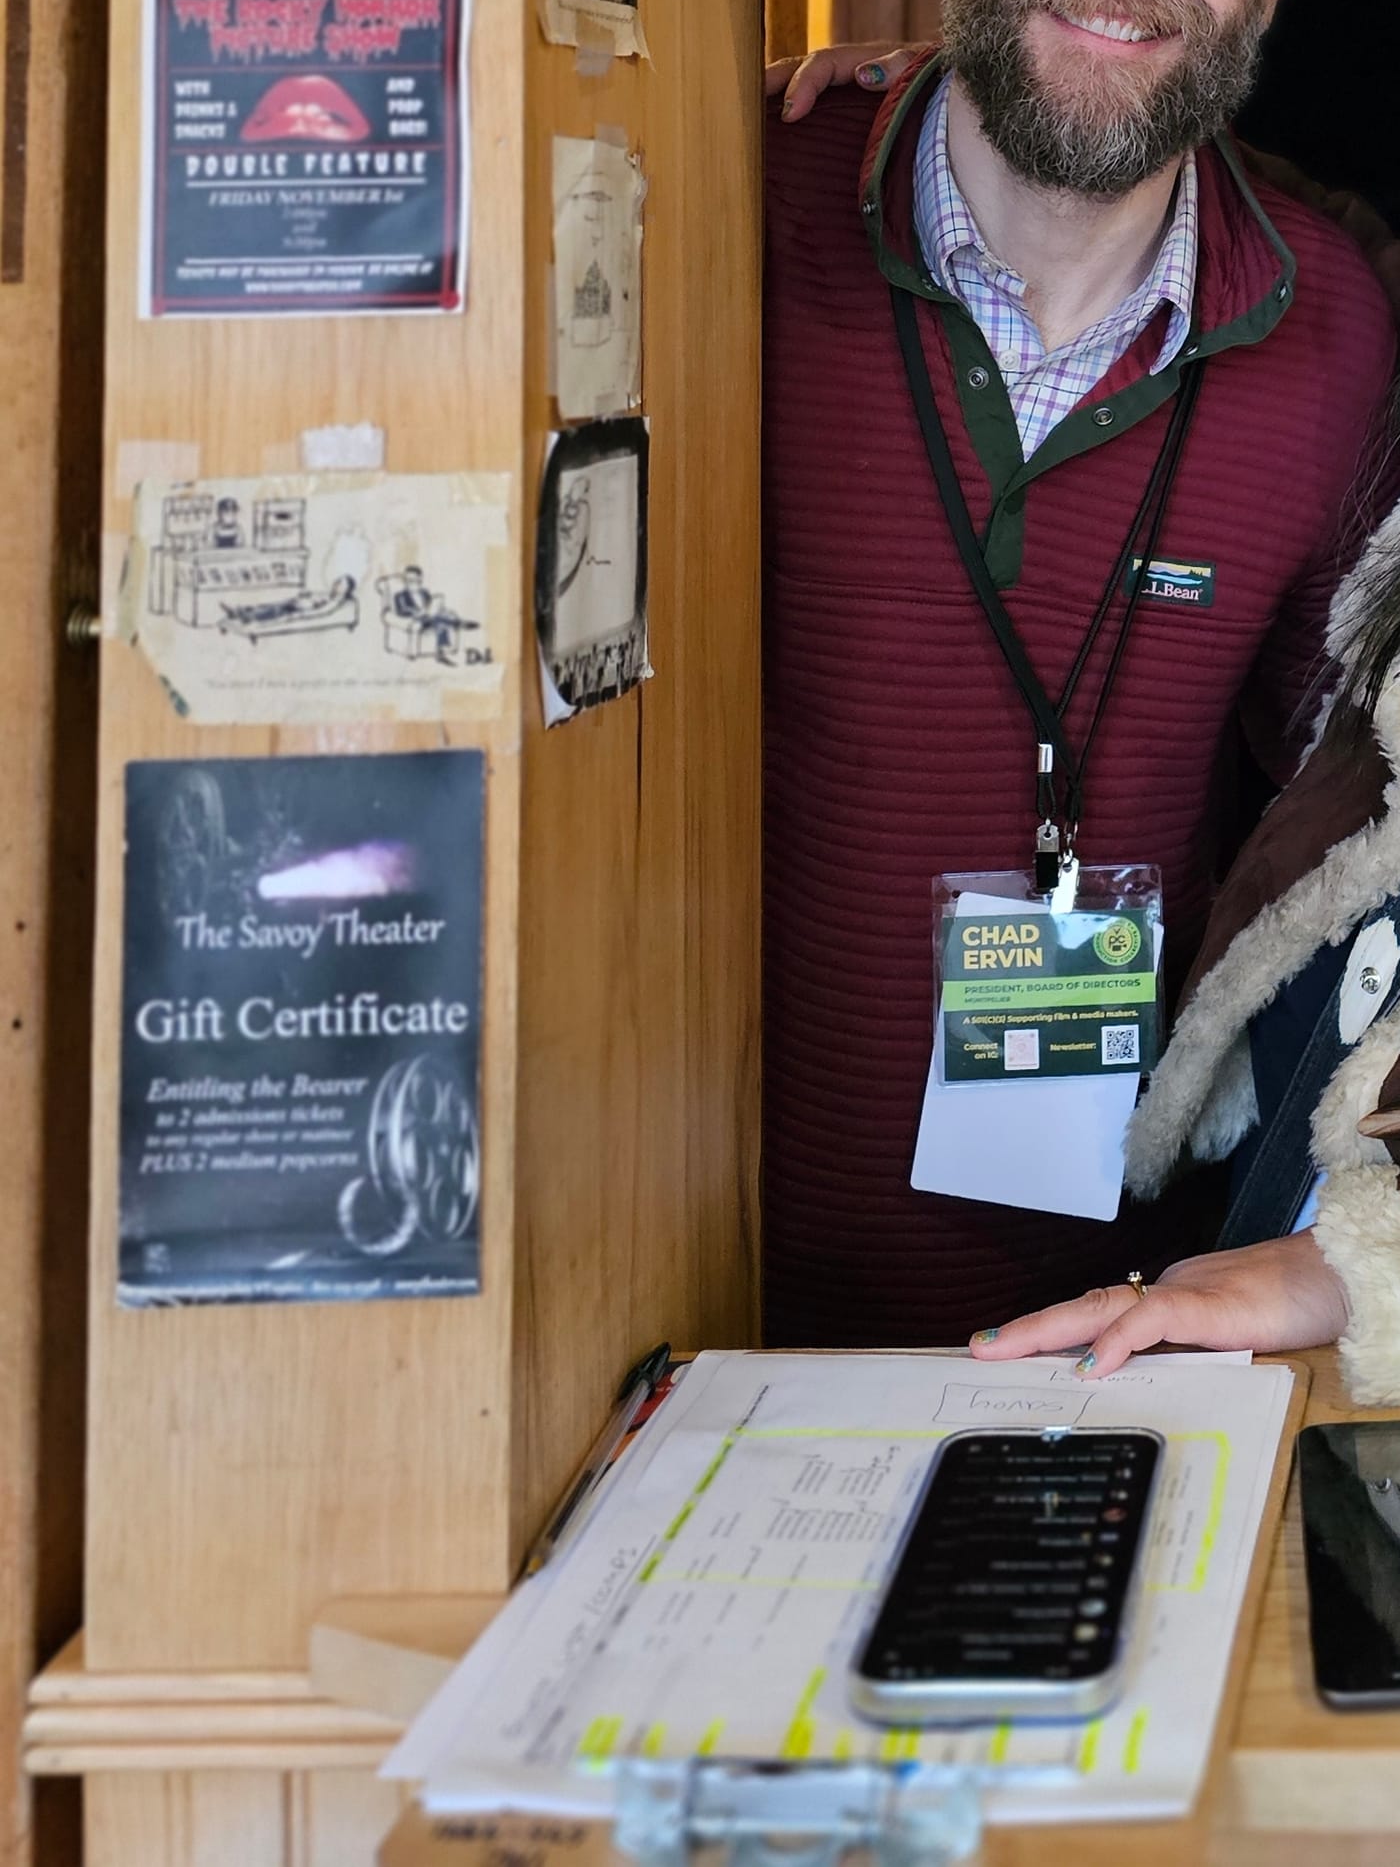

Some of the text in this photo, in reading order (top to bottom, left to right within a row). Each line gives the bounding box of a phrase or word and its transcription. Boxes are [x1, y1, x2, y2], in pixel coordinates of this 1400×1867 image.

[186, 152, 426, 176] DOUBLE FEATURE
[175, 907, 446, 959] The Savoy Theater
[962, 924, 1040, 947] CHAD
[963, 947, 1043, 970] ERVIN
[964, 978, 1141, 995] PRESIDENT, BOARD OF DIRECTORS
[136, 992, 469, 1043] Gift Certificate
[1008, 1013, 1052, 1023] Supporting
[963, 1043, 998, 1051] Connect
[147, 1073, 368, 1104] Entitling the Bearer
[140, 1153, 193, 1174] PLUS
